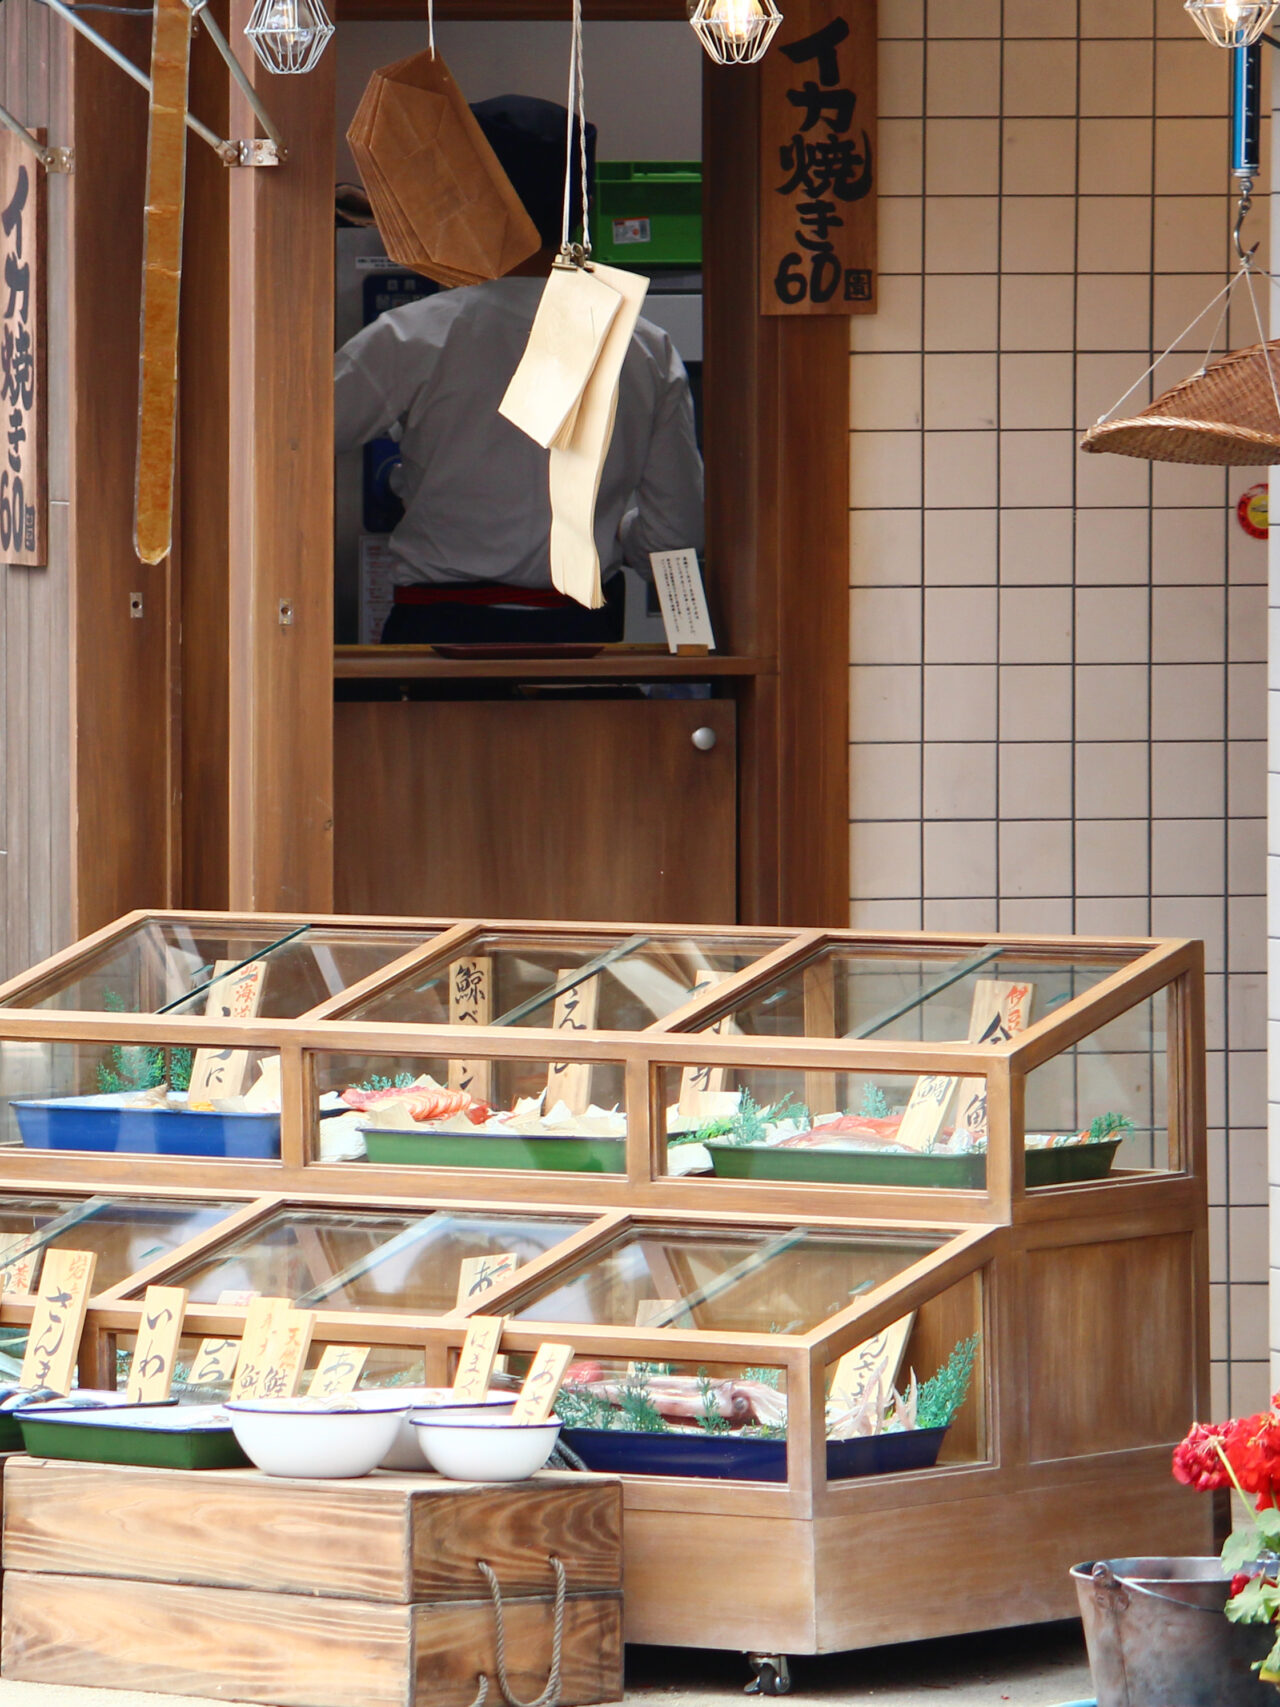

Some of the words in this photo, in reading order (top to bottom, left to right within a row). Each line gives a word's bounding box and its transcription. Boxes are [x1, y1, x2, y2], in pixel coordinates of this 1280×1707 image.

[33, 1285, 73, 1392] さんま
[519, 1355, 554, 1427] あさ
